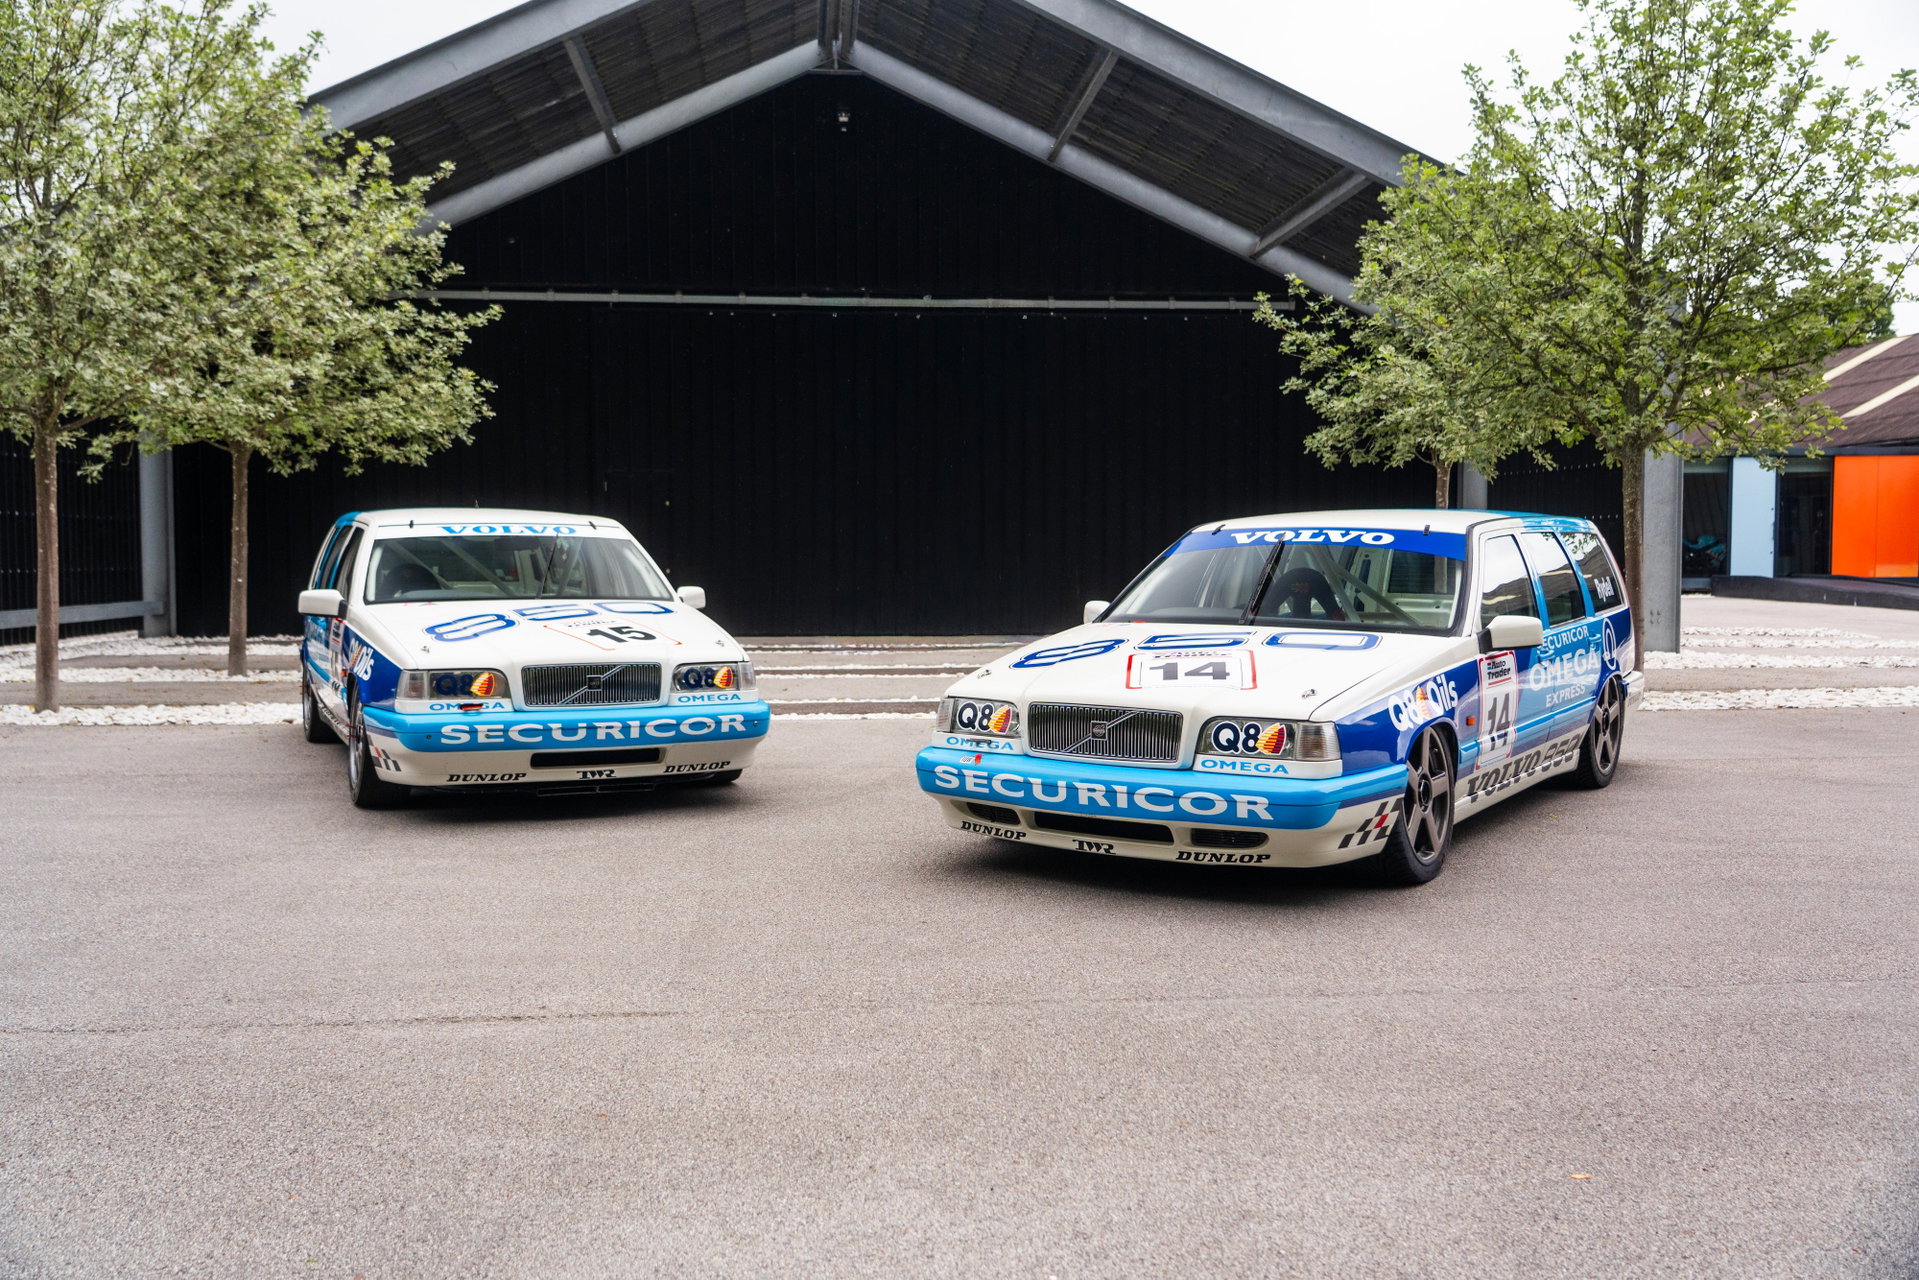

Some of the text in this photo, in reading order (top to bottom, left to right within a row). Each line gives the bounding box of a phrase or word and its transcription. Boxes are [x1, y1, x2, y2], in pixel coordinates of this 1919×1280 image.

[439, 525, 577, 535] VOLVO
[1231, 529, 1395, 546] VOLVO
[423, 602, 676, 643] 850
[586, 626, 656, 643] 15
[1008, 631, 1383, 670] 850
[1149, 661, 1230, 681] 14
[1487, 667, 1511, 680] Trader
[1491, 660, 1506, 670] Auto
[1529, 648, 1600, 692] OMEGA
[435, 673, 474, 696] Q8
[684, 667, 716, 689] Q8
[678, 693, 741, 703] OMEGA
[1388, 674, 1458, 732] Q8 Oils
[1545, 683, 1586, 708] EXPRESS
[429, 701, 506, 712] OMGA
[957, 701, 995, 732] Q8
[440, 713, 747, 745] SECURICOR
[1487, 693, 1512, 752] 14
[1211, 721, 1262, 754] Q8
[576, 768, 617, 780] TWR
[663, 760, 731, 774] DUNLOP
[1200, 759, 1289, 775] OMEGA
[1467, 733, 1585, 804] VOLVO 850
[446, 772, 528, 783] DUNLOP
[934, 765, 1275, 821] SECURICOR
[960, 820, 1027, 841] DUNLOP
[1072, 838, 1117, 855] TWR
[1175, 850, 1271, 865] DUNLOP
